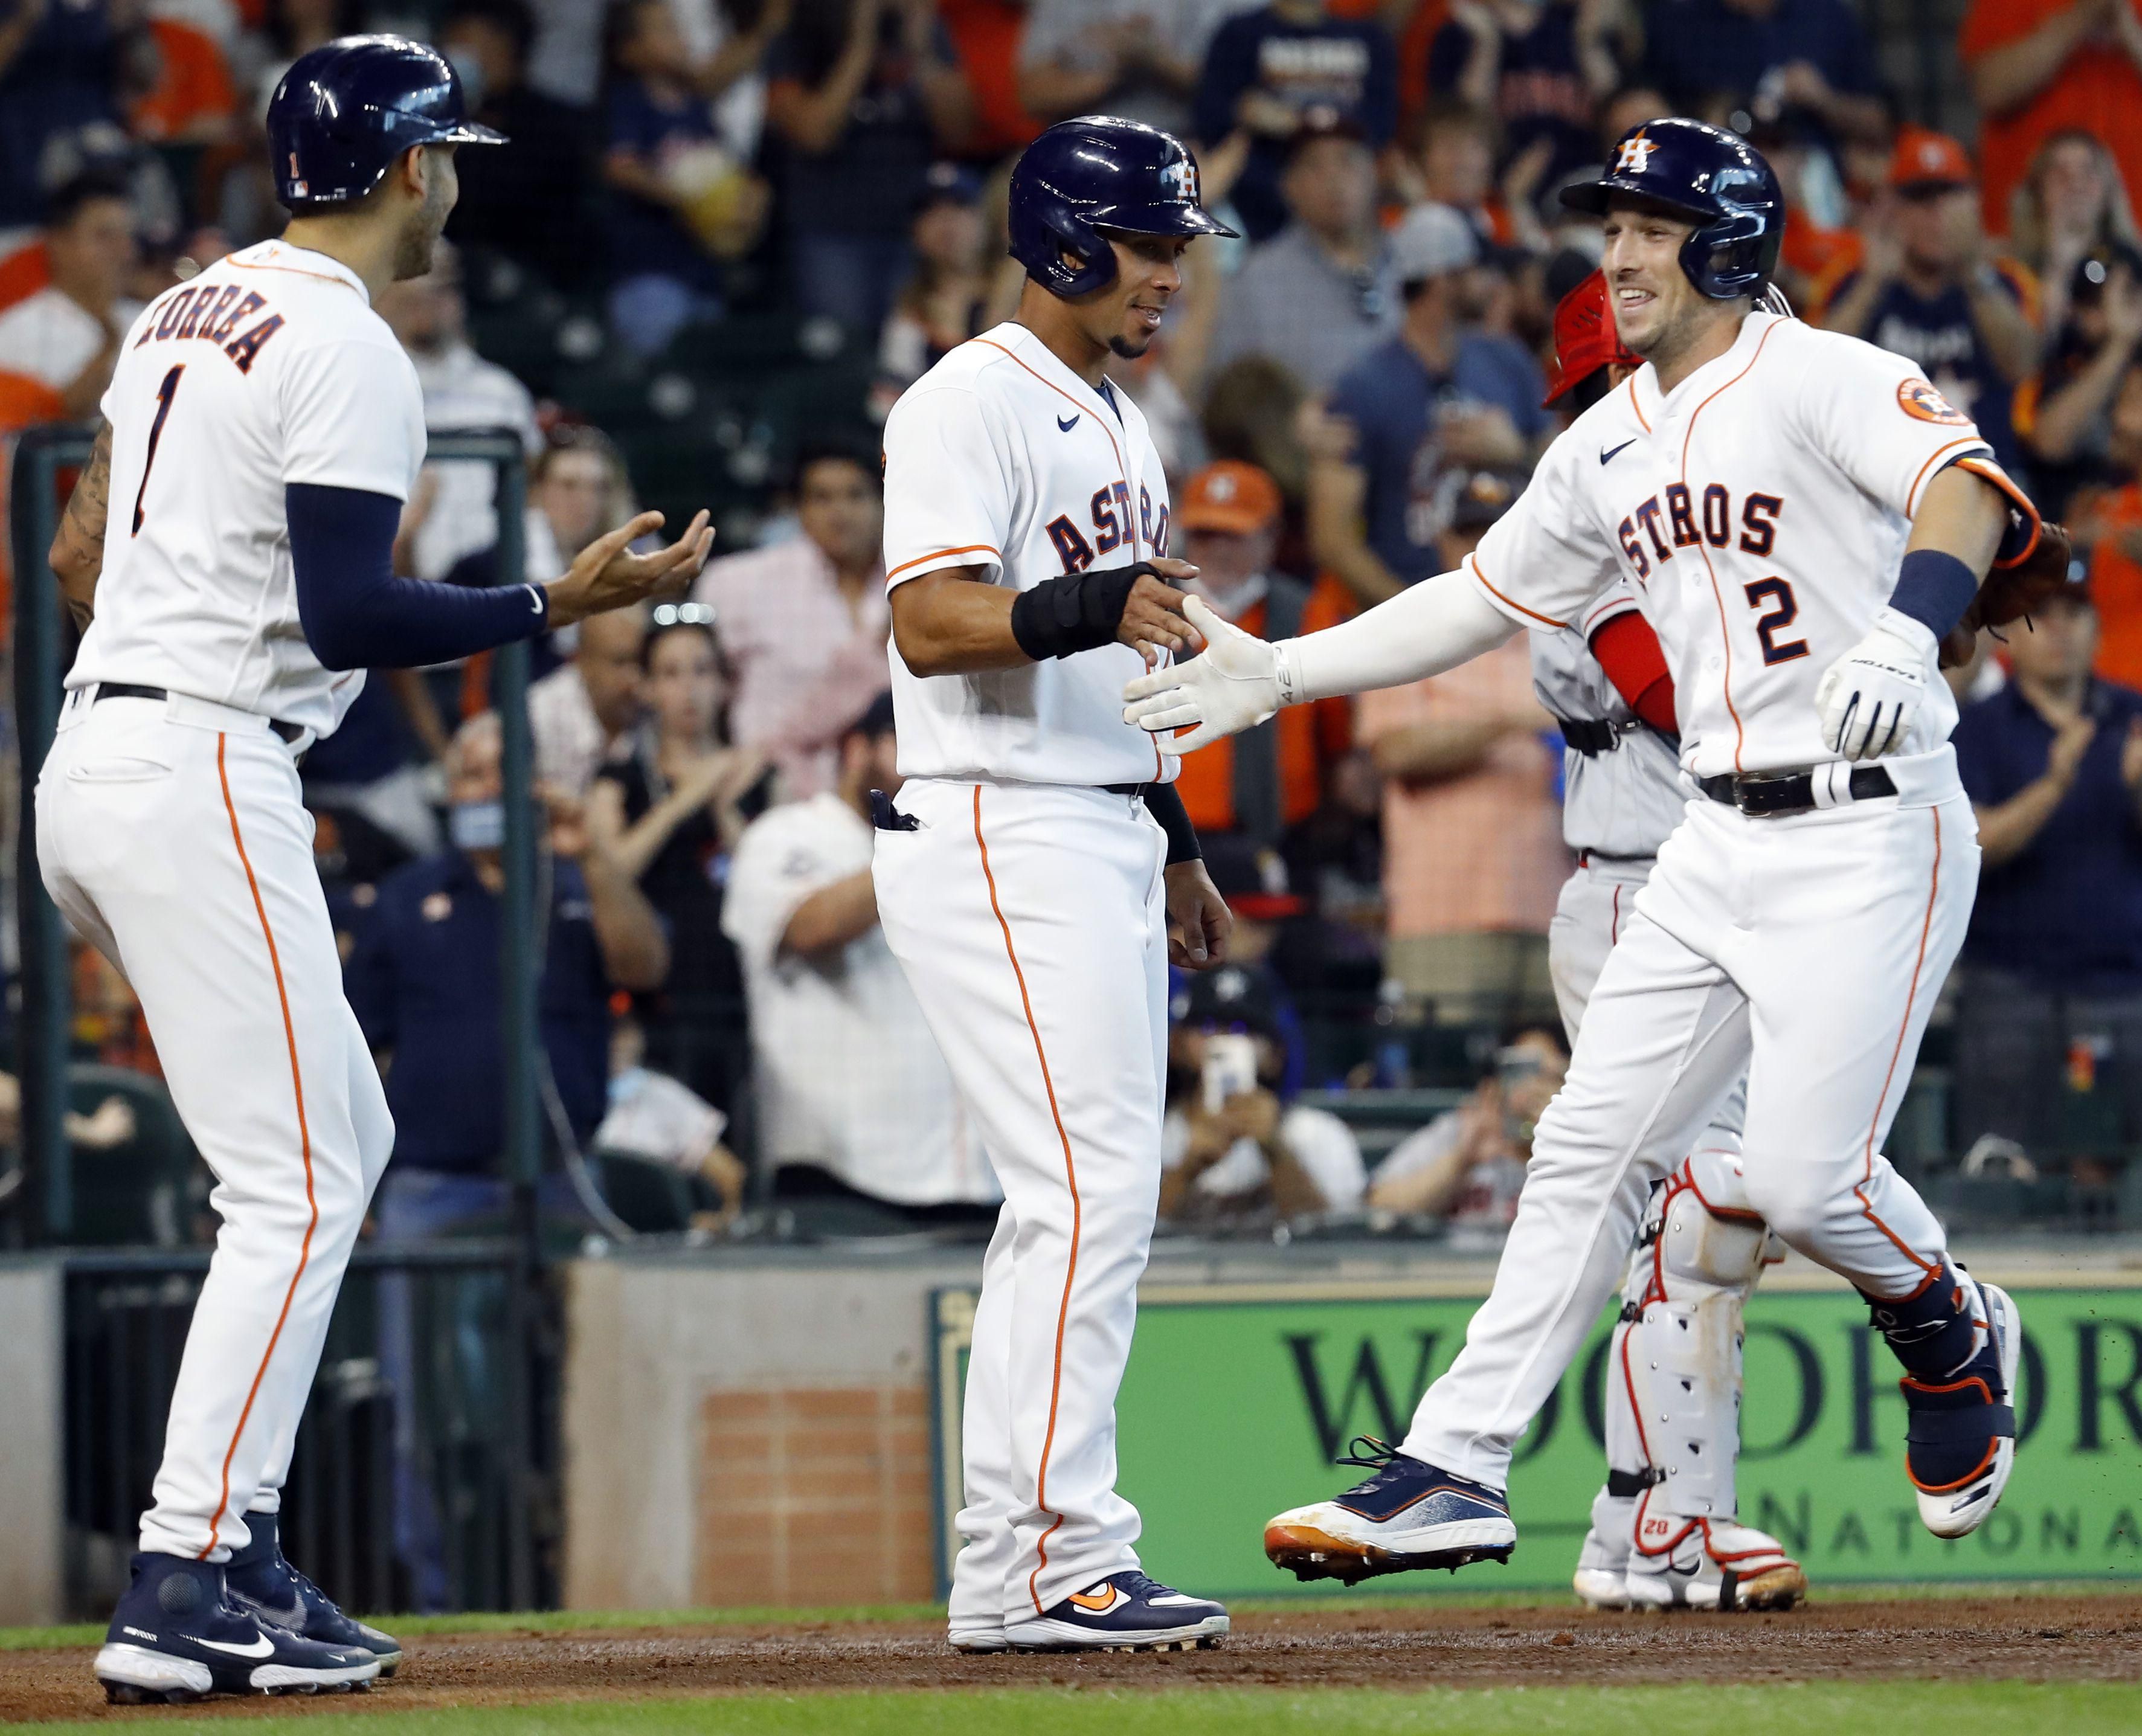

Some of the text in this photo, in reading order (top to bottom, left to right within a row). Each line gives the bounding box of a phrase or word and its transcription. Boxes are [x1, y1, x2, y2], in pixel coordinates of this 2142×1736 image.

[289, 152, 300, 179] 1
[133, 284, 285, 375] CORREA
[131, 362, 186, 538] 1
[1618, 481, 1784, 583] STROS
[1744, 576, 1810, 667] 2
[1644, 1519, 1668, 1535] 28
[1757, 1491, 2142, 1557] NATONA
